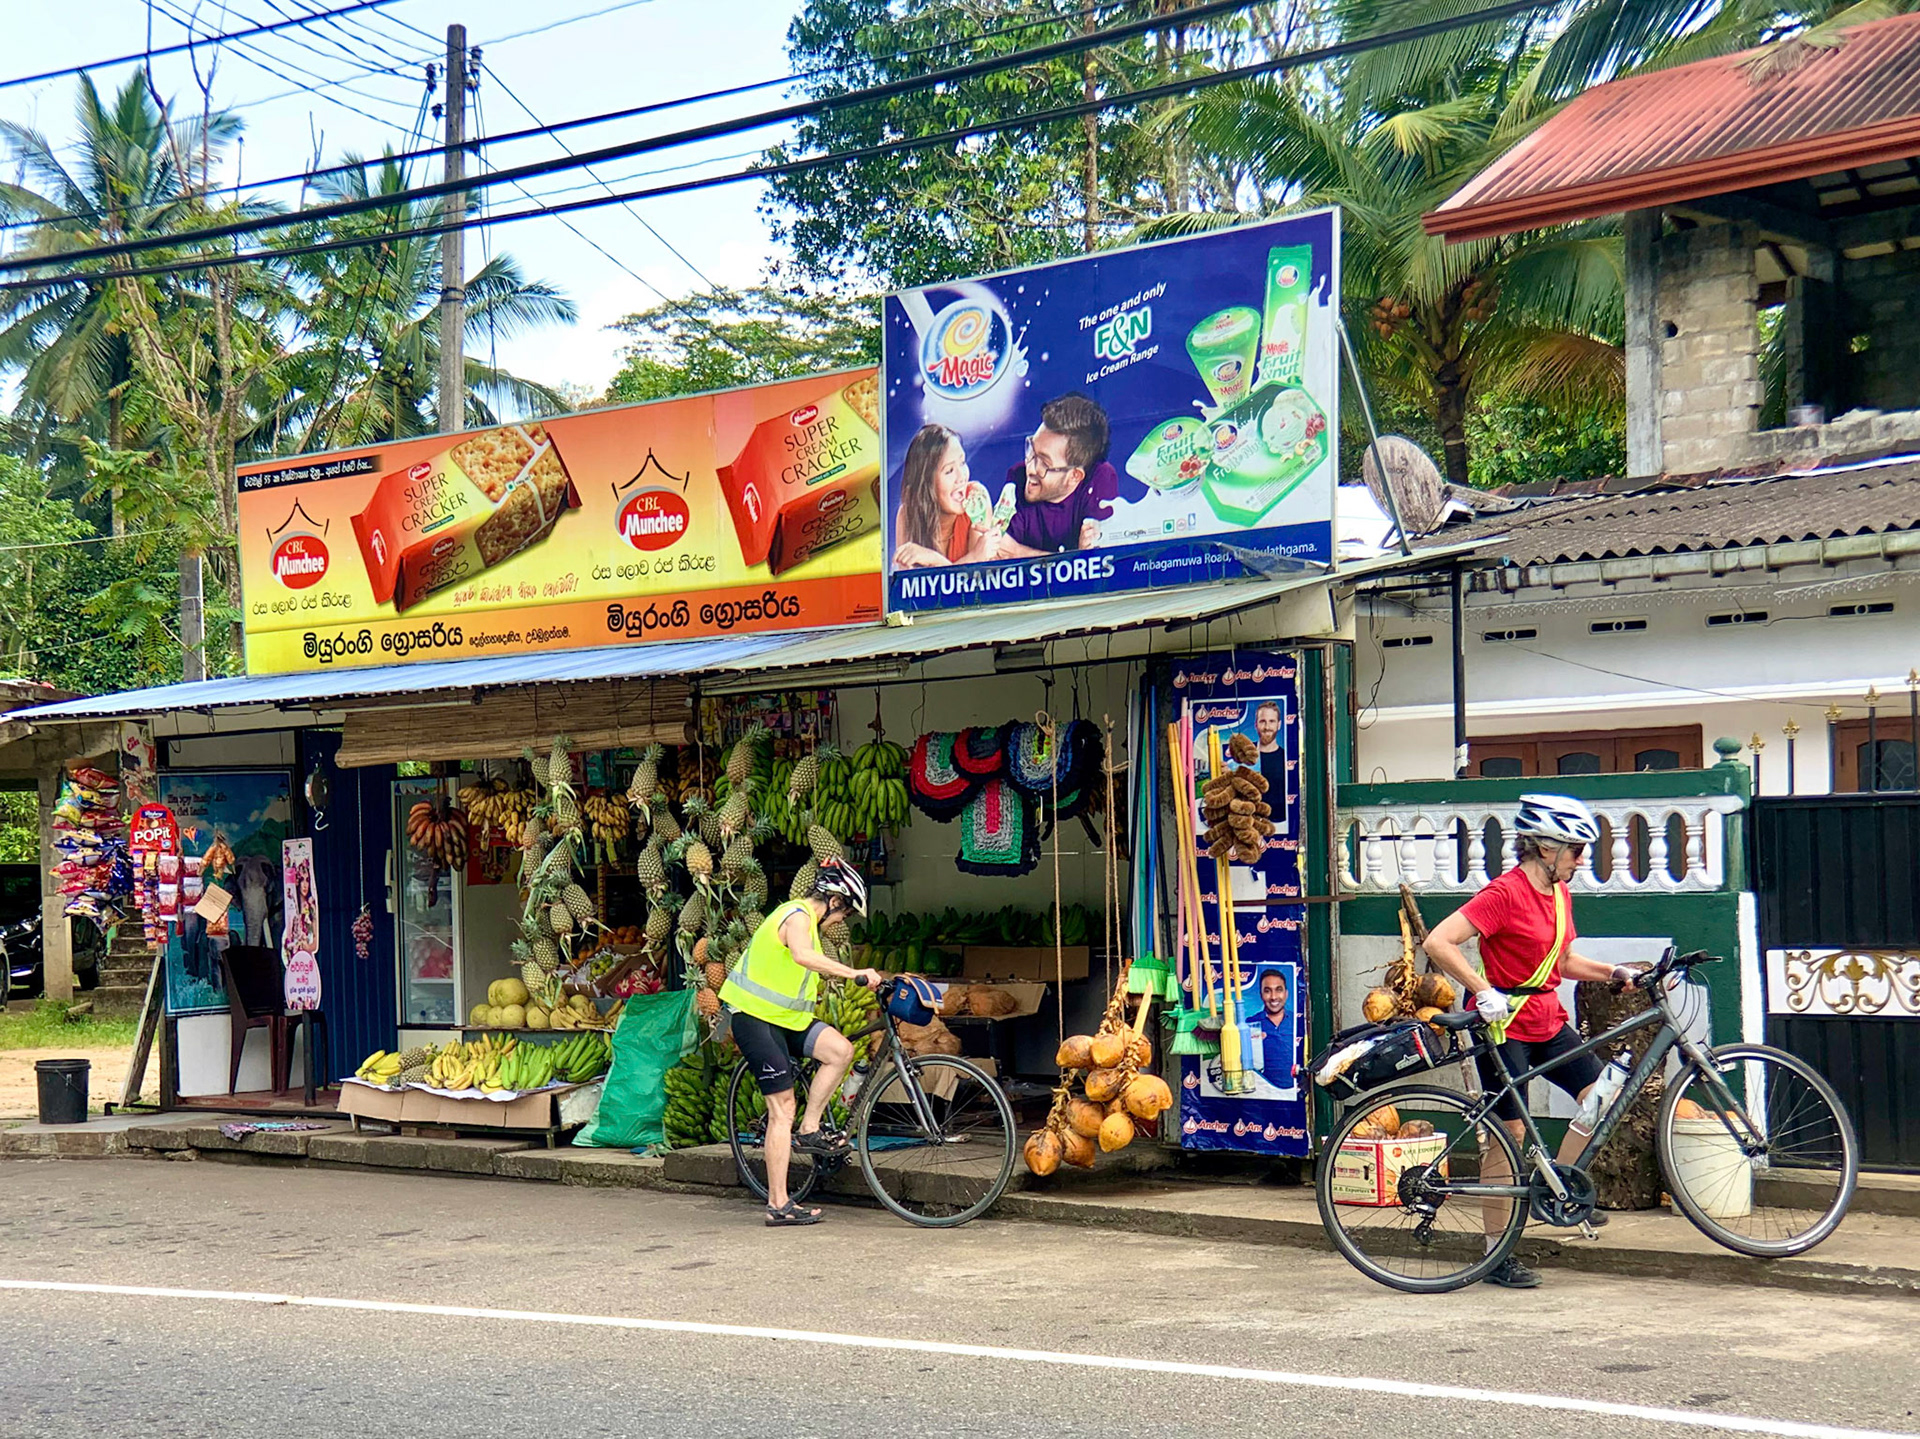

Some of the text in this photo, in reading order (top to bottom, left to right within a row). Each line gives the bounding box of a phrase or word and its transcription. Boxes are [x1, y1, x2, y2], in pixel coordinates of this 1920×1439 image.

[1079, 281, 1167, 331] The one and only
[1097, 310, 1149, 357] F&N
[1085, 344, 1160, 384] Ice Cream Range
[1262, 349, 1302, 369] Fruit
[928, 355, 994, 386] Magic
[1261, 362, 1299, 381] &nut
[784, 416, 839, 452] SUPER
[1157, 432, 1195, 458] Fruit
[796, 435, 838, 460] CREAM
[781, 438, 863, 485] CRACKER
[403, 472, 449, 503] SUPER
[413, 490, 447, 511] CREAM
[636, 496, 661, 512] CBL
[401, 492, 468, 532] CRACKER
[626, 510, 683, 536] Munchee
[286, 541, 306, 554] CBL
[277, 552, 325, 576] Munchee
[1133, 556, 1202, 573] Ambagamuwa
[1204, 552, 1232, 565] Road,
[901, 555, 1115, 598] MIYURANGI STORES
[1265, 666, 1295, 678] Anchor
[1209, 706, 1241, 718] Anchor
[134, 827, 171, 843] POPit
[1267, 838, 1298, 849] Anchor
[1268, 883, 1298, 895] Anchor
[1199, 1119, 1229, 1130] Anchor
[1277, 1126, 1305, 1137] Anchor
